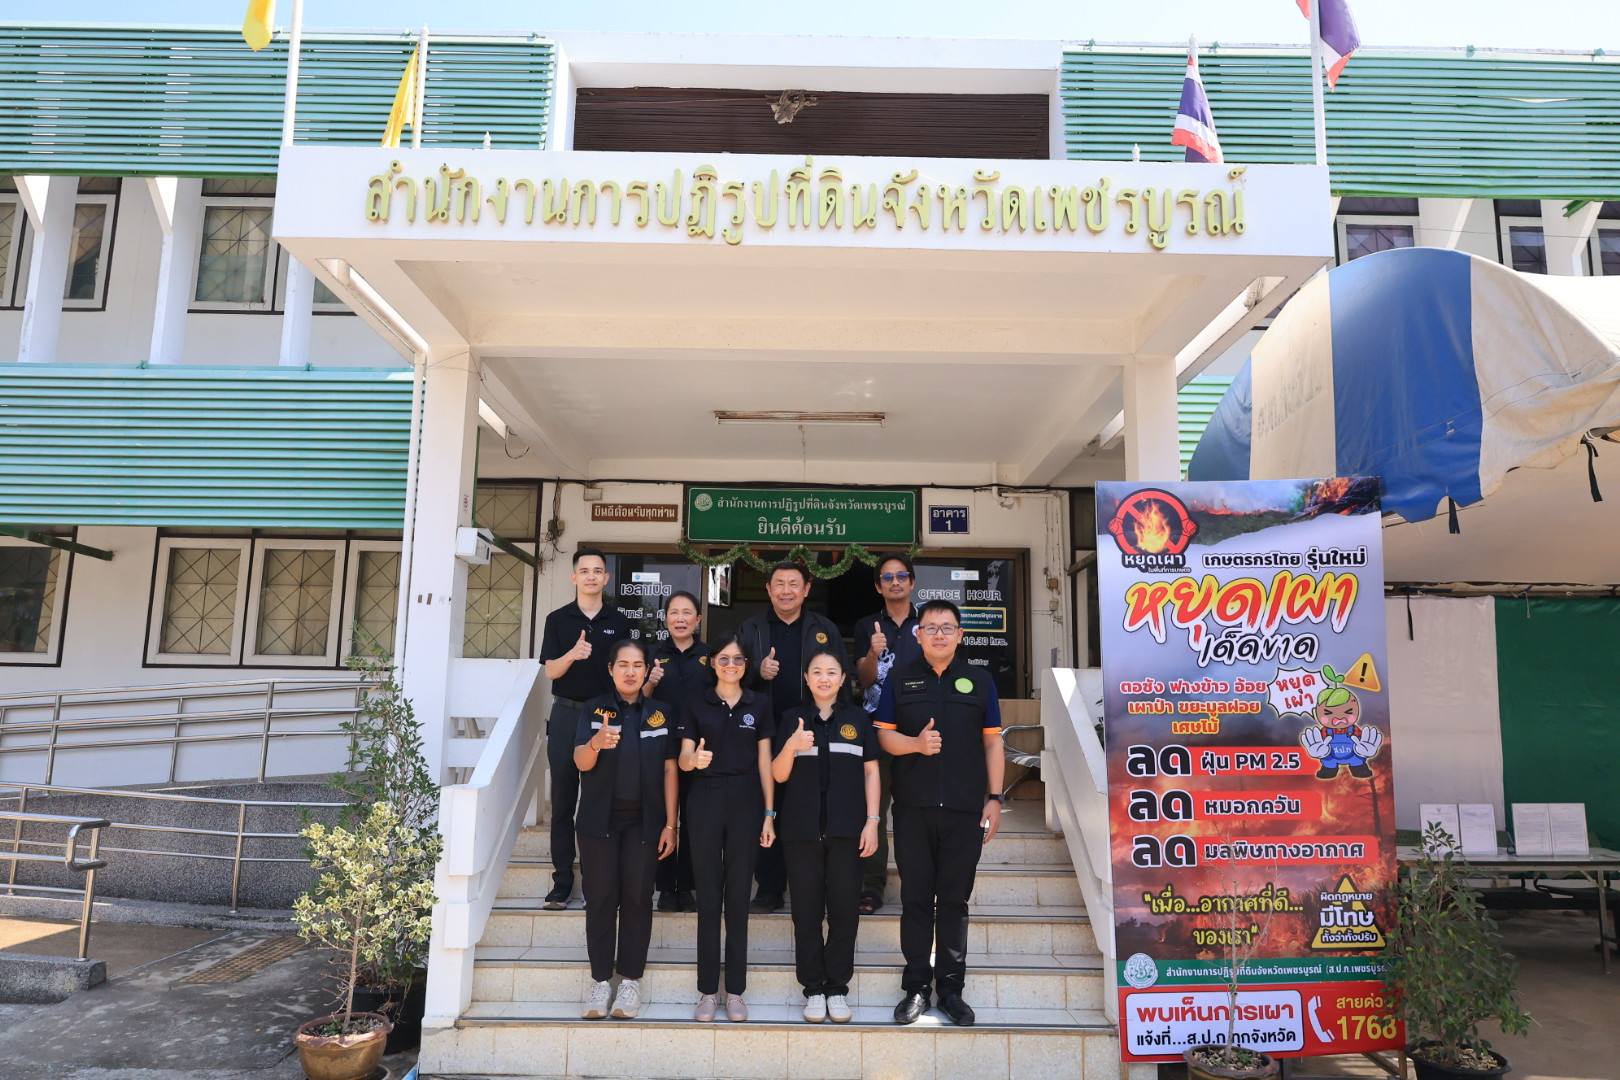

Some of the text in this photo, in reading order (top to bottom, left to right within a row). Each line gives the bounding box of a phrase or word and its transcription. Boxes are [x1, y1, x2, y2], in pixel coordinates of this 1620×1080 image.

[364, 155, 1247, 250] สำนักงานการปฏิรูปที่ดินจังหวัดเพชรบูรณ์
[717, 494, 906, 513] สำนักงานการปฏิรูปที่ดินจังหวัดเพชรบูรณ์
[932, 509, 966, 519] อาคาร
[757, 516, 846, 536] ยินดีต้อนรับ
[944, 520, 952, 531] 1
[1124, 554, 1184, 569] หยุดเผา
[1204, 547, 1366, 571] เกษตรกรไทย รุ่นใหม่
[918, 588, 1002, 601] OFFICE HOUR
[1126, 572, 1356, 643] หยุดเผา
[963, 635, 989, 646] 16.30
[1200, 627, 1316, 665] เด็ดขาด
[1120, 676, 1267, 694] ตอซัง ฟางข้าว อ้อย
[1275, 674, 1316, 694] หยุด
[1128, 698, 1261, 717] เผาป่า ขยะมูลฝอย
[1284, 693, 1314, 709] เผา
[1171, 717, 1219, 734] เศษไม้
[1126, 744, 1301, 777] ลด ฝุ่น PM 2.5
[1128, 789, 1301, 822] ลด หมอกควัน
[1131, 834, 1364, 868] ลด มลพิษทางอากาศ
[1320, 905, 1375, 927] มีโทษ
[1321, 929, 1377, 942] ทั้งจำทั้งปรับ
[1136, 996, 1294, 1022] พบเห็นการเผา
